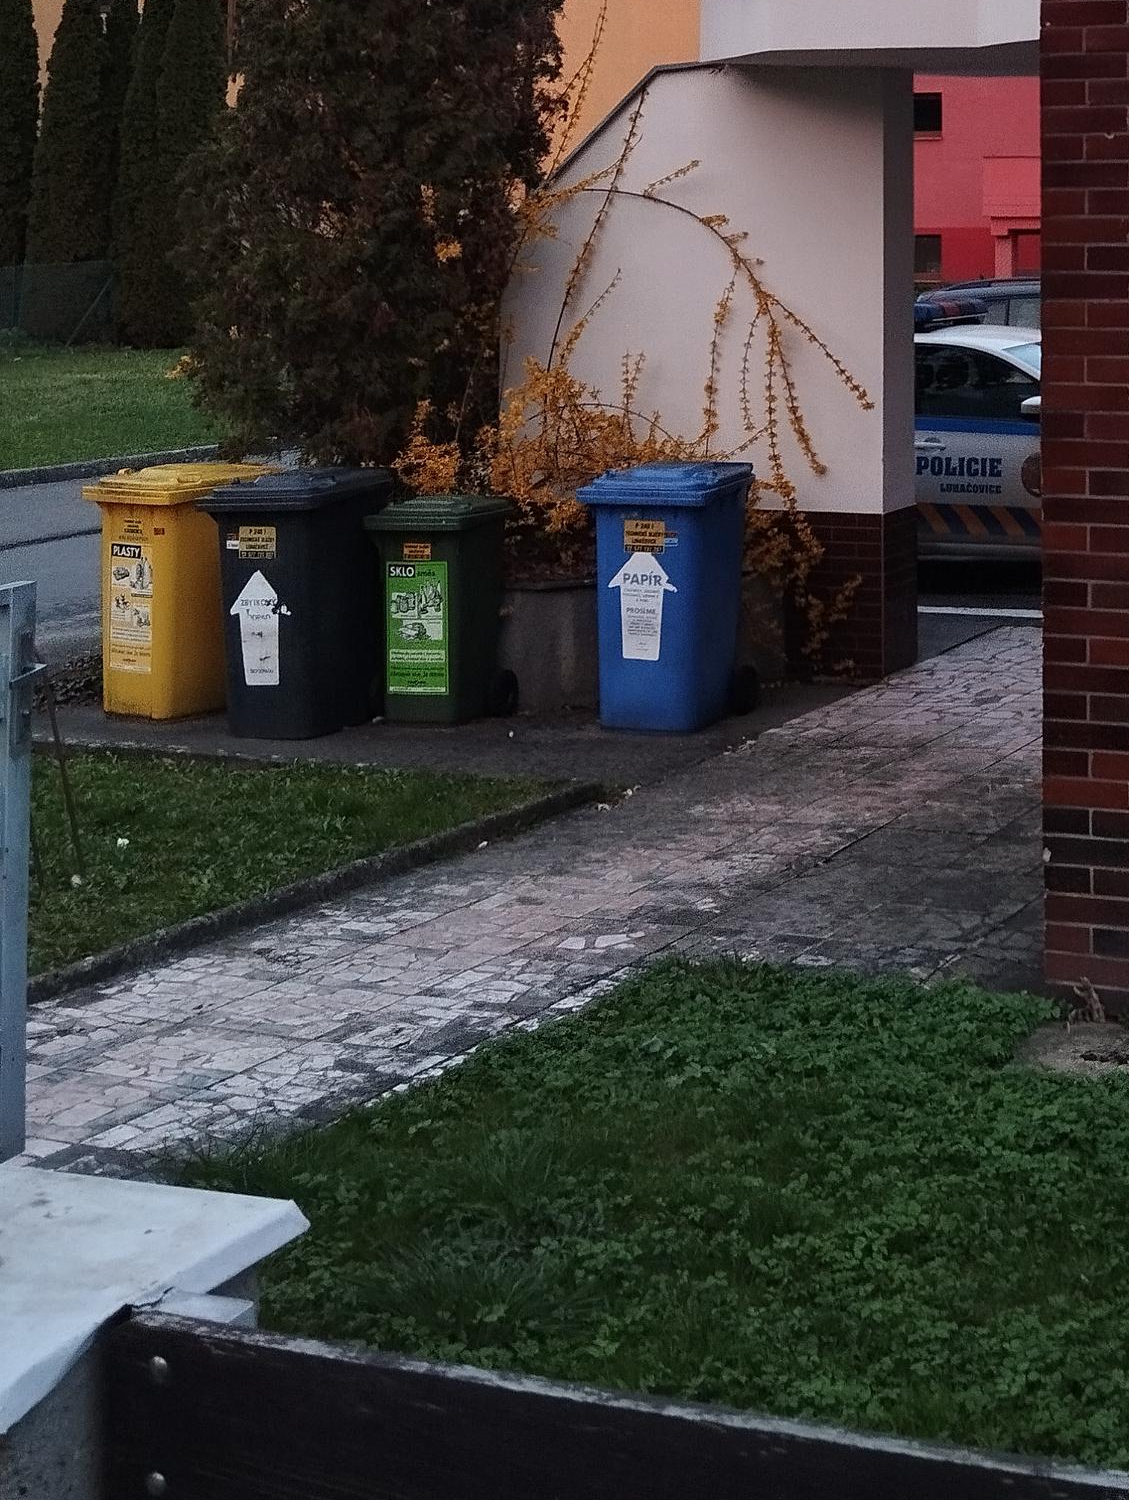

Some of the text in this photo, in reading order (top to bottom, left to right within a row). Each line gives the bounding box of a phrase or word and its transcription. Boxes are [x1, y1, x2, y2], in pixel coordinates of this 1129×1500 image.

[916, 455, 1002, 478] POLICIE
[940, 481, 1002, 495] LUHAČOVICE
[113, 545, 140, 558] PLASTY
[390, 566, 414, 577] SKLO
[623, 571, 662, 587] PAPÍR
